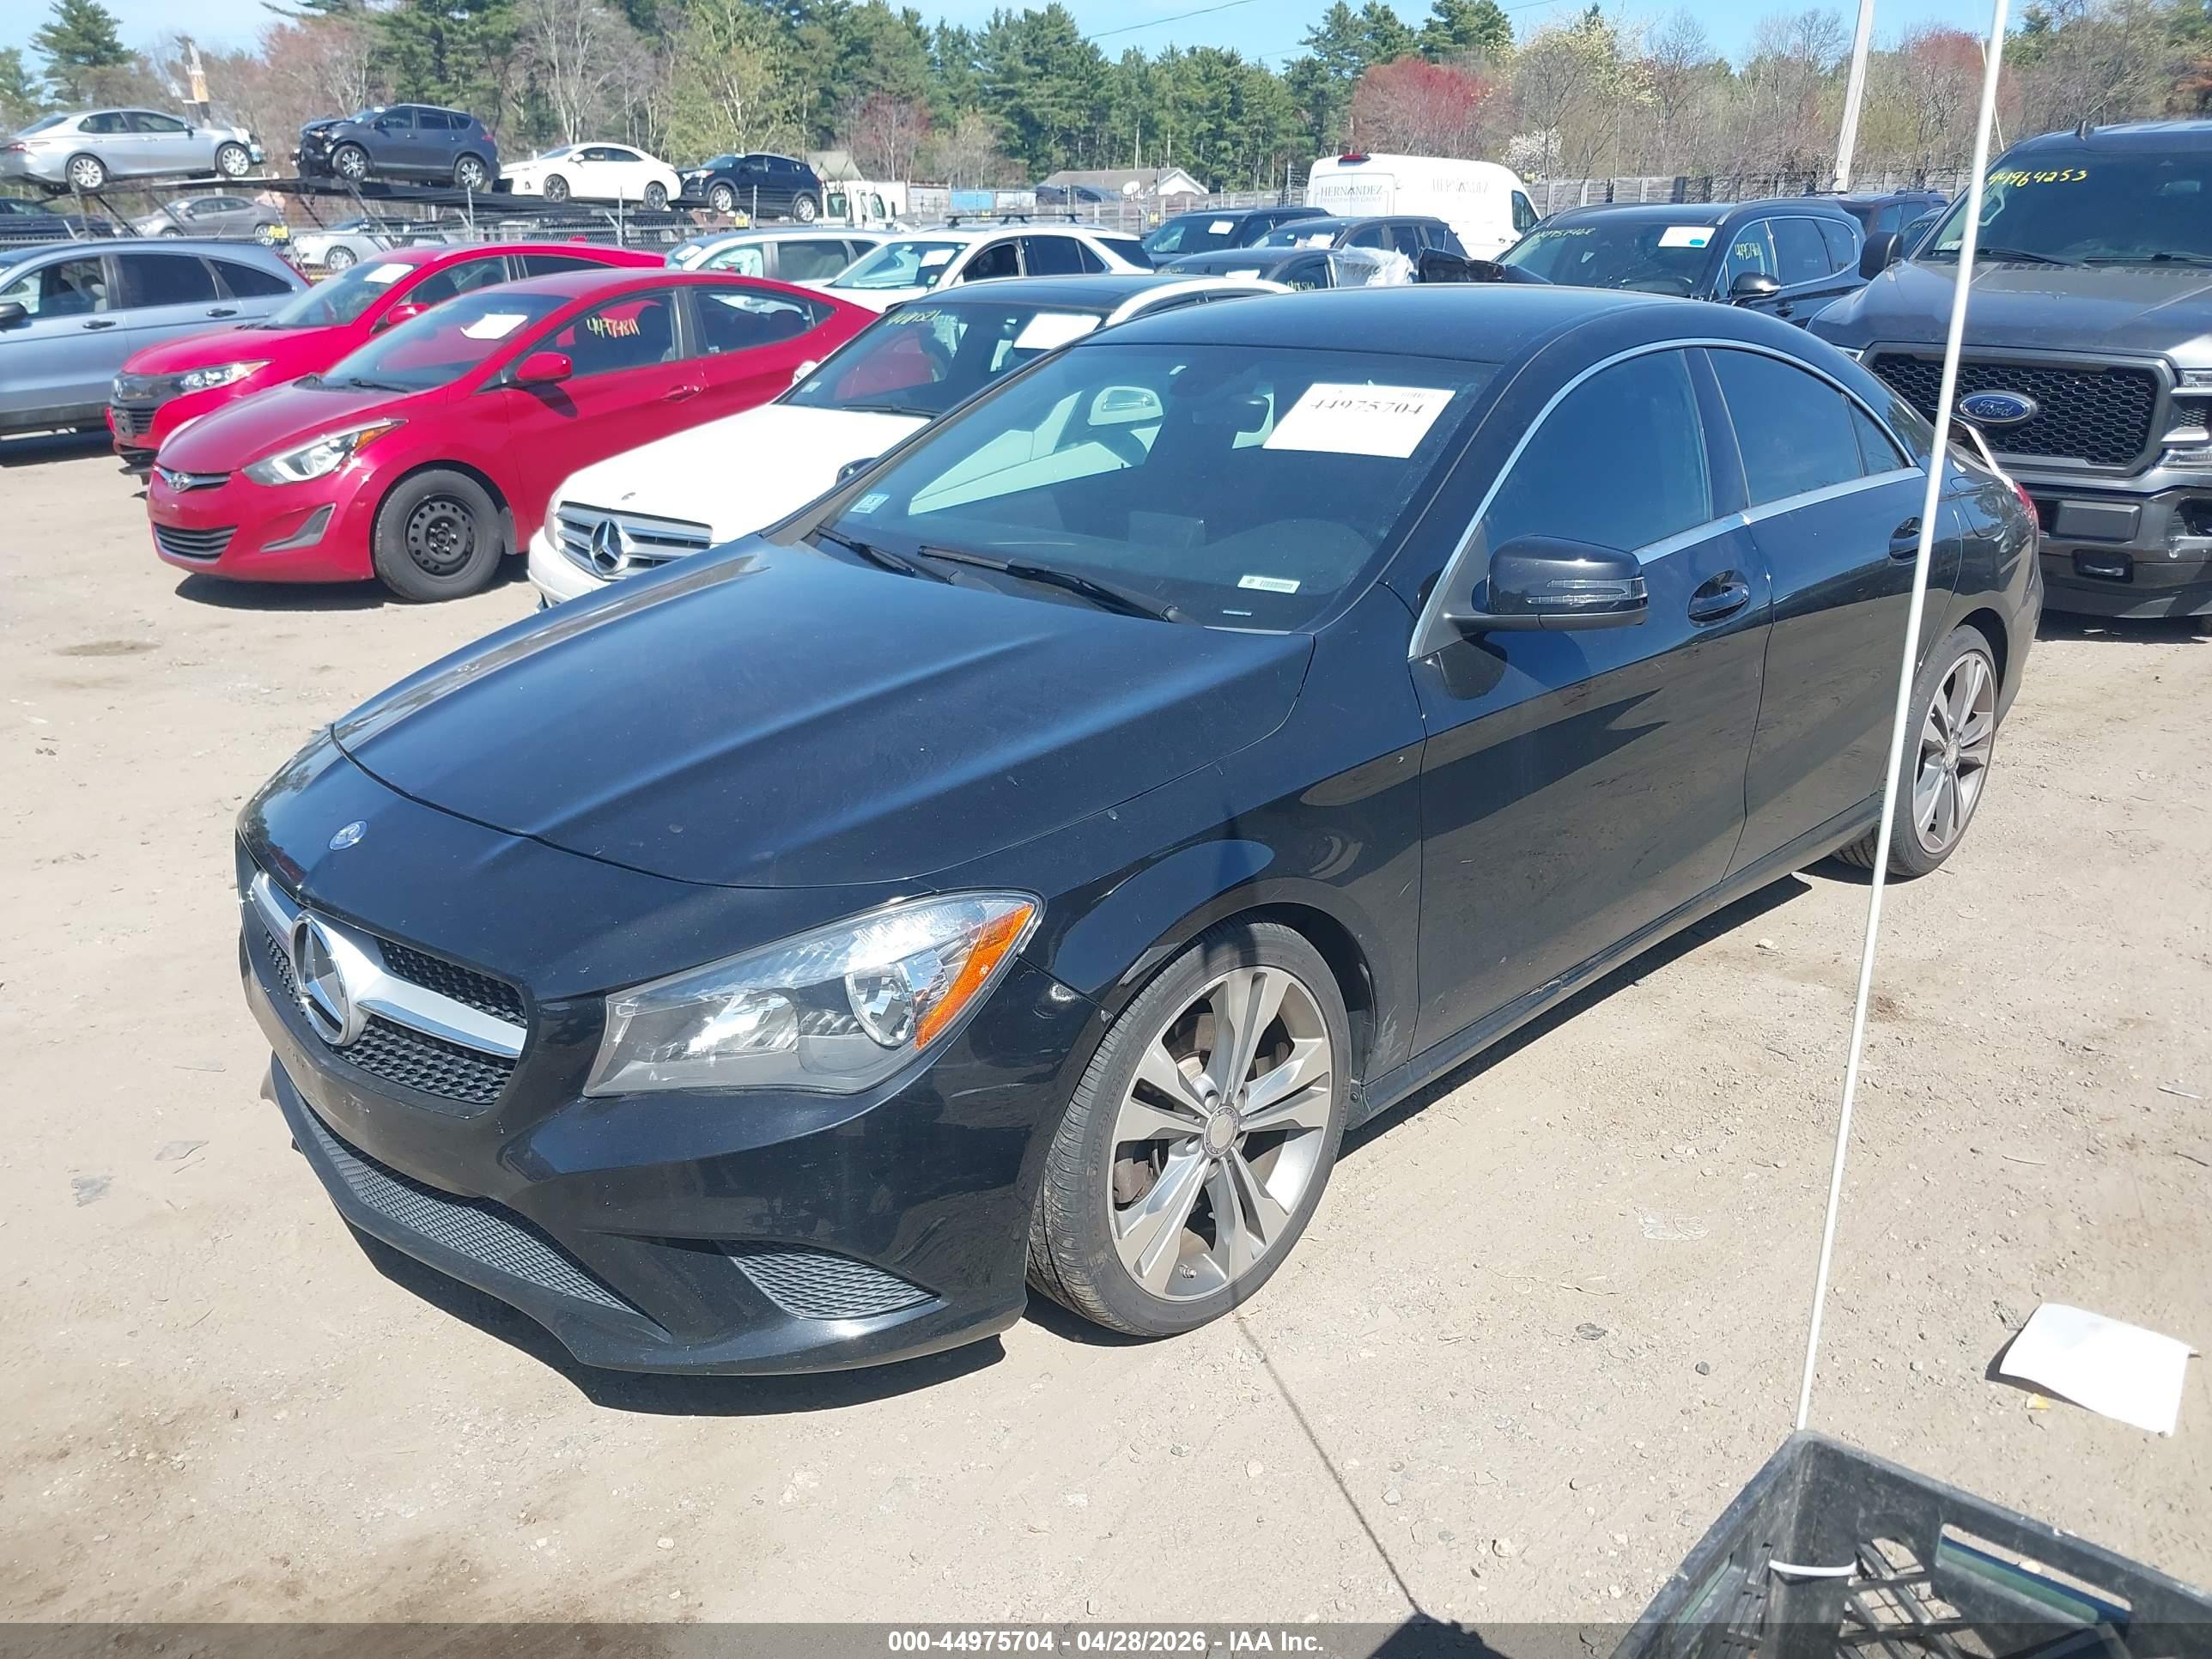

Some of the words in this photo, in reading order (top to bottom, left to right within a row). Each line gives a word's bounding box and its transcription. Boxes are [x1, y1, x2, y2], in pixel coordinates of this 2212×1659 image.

[1988, 168, 2087, 187] 44964253
[1320, 185, 1382, 198] HERNANDEZ
[1310, 398, 1425, 415] 44975704
[1975, 399, 2014, 416] Ford
